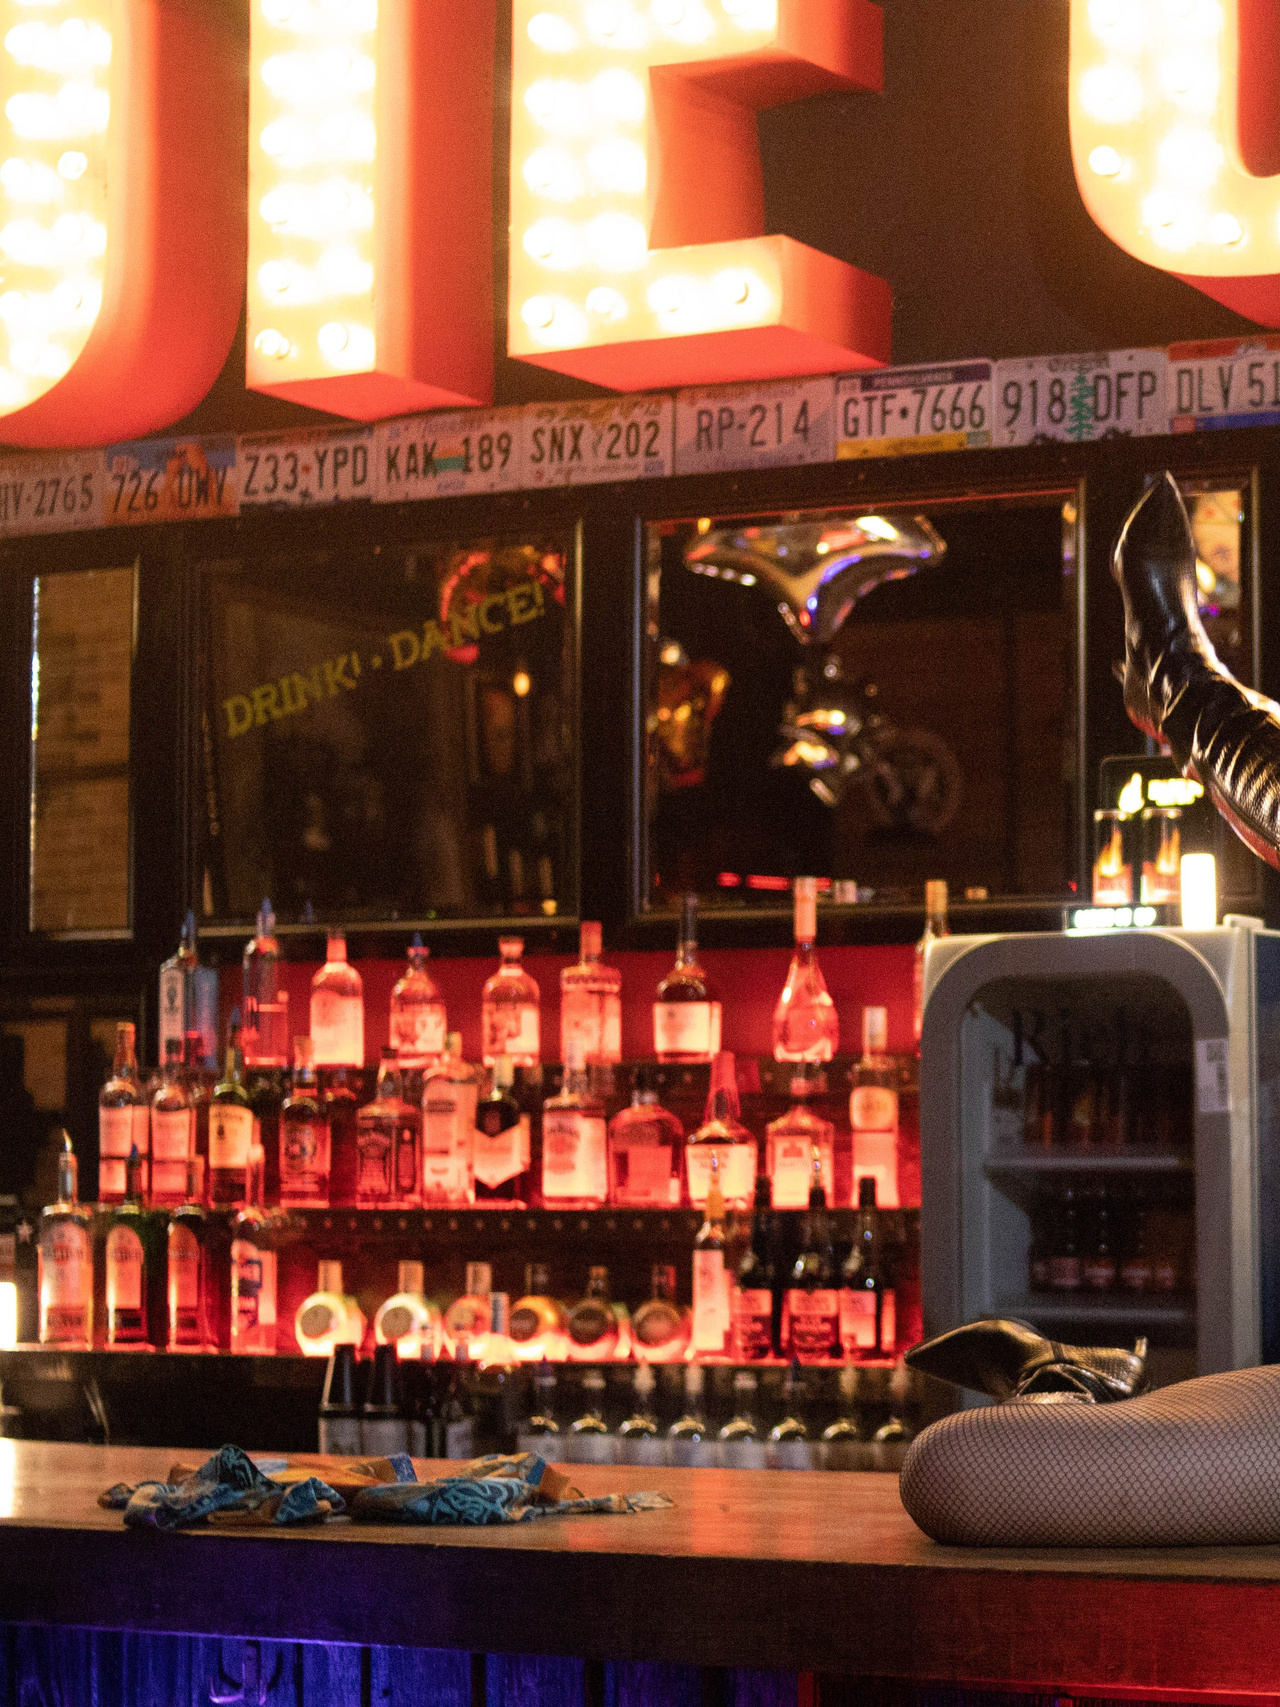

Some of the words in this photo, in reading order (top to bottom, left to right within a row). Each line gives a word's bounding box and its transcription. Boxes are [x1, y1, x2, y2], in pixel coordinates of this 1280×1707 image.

[1003, 377, 1067, 428] 918
[1093, 370, 1157, 422] DFP
[1176, 363, 1234, 414] DLV
[386, 440, 438, 483] KAK
[462, 431, 513, 474] 189
[530, 423, 585, 464] SNX
[606, 419, 660, 460] 202
[110, 469, 159, 514] 726
[221, 652, 361, 738] DRINK!
[388, 581, 546, 671] DANCE!
